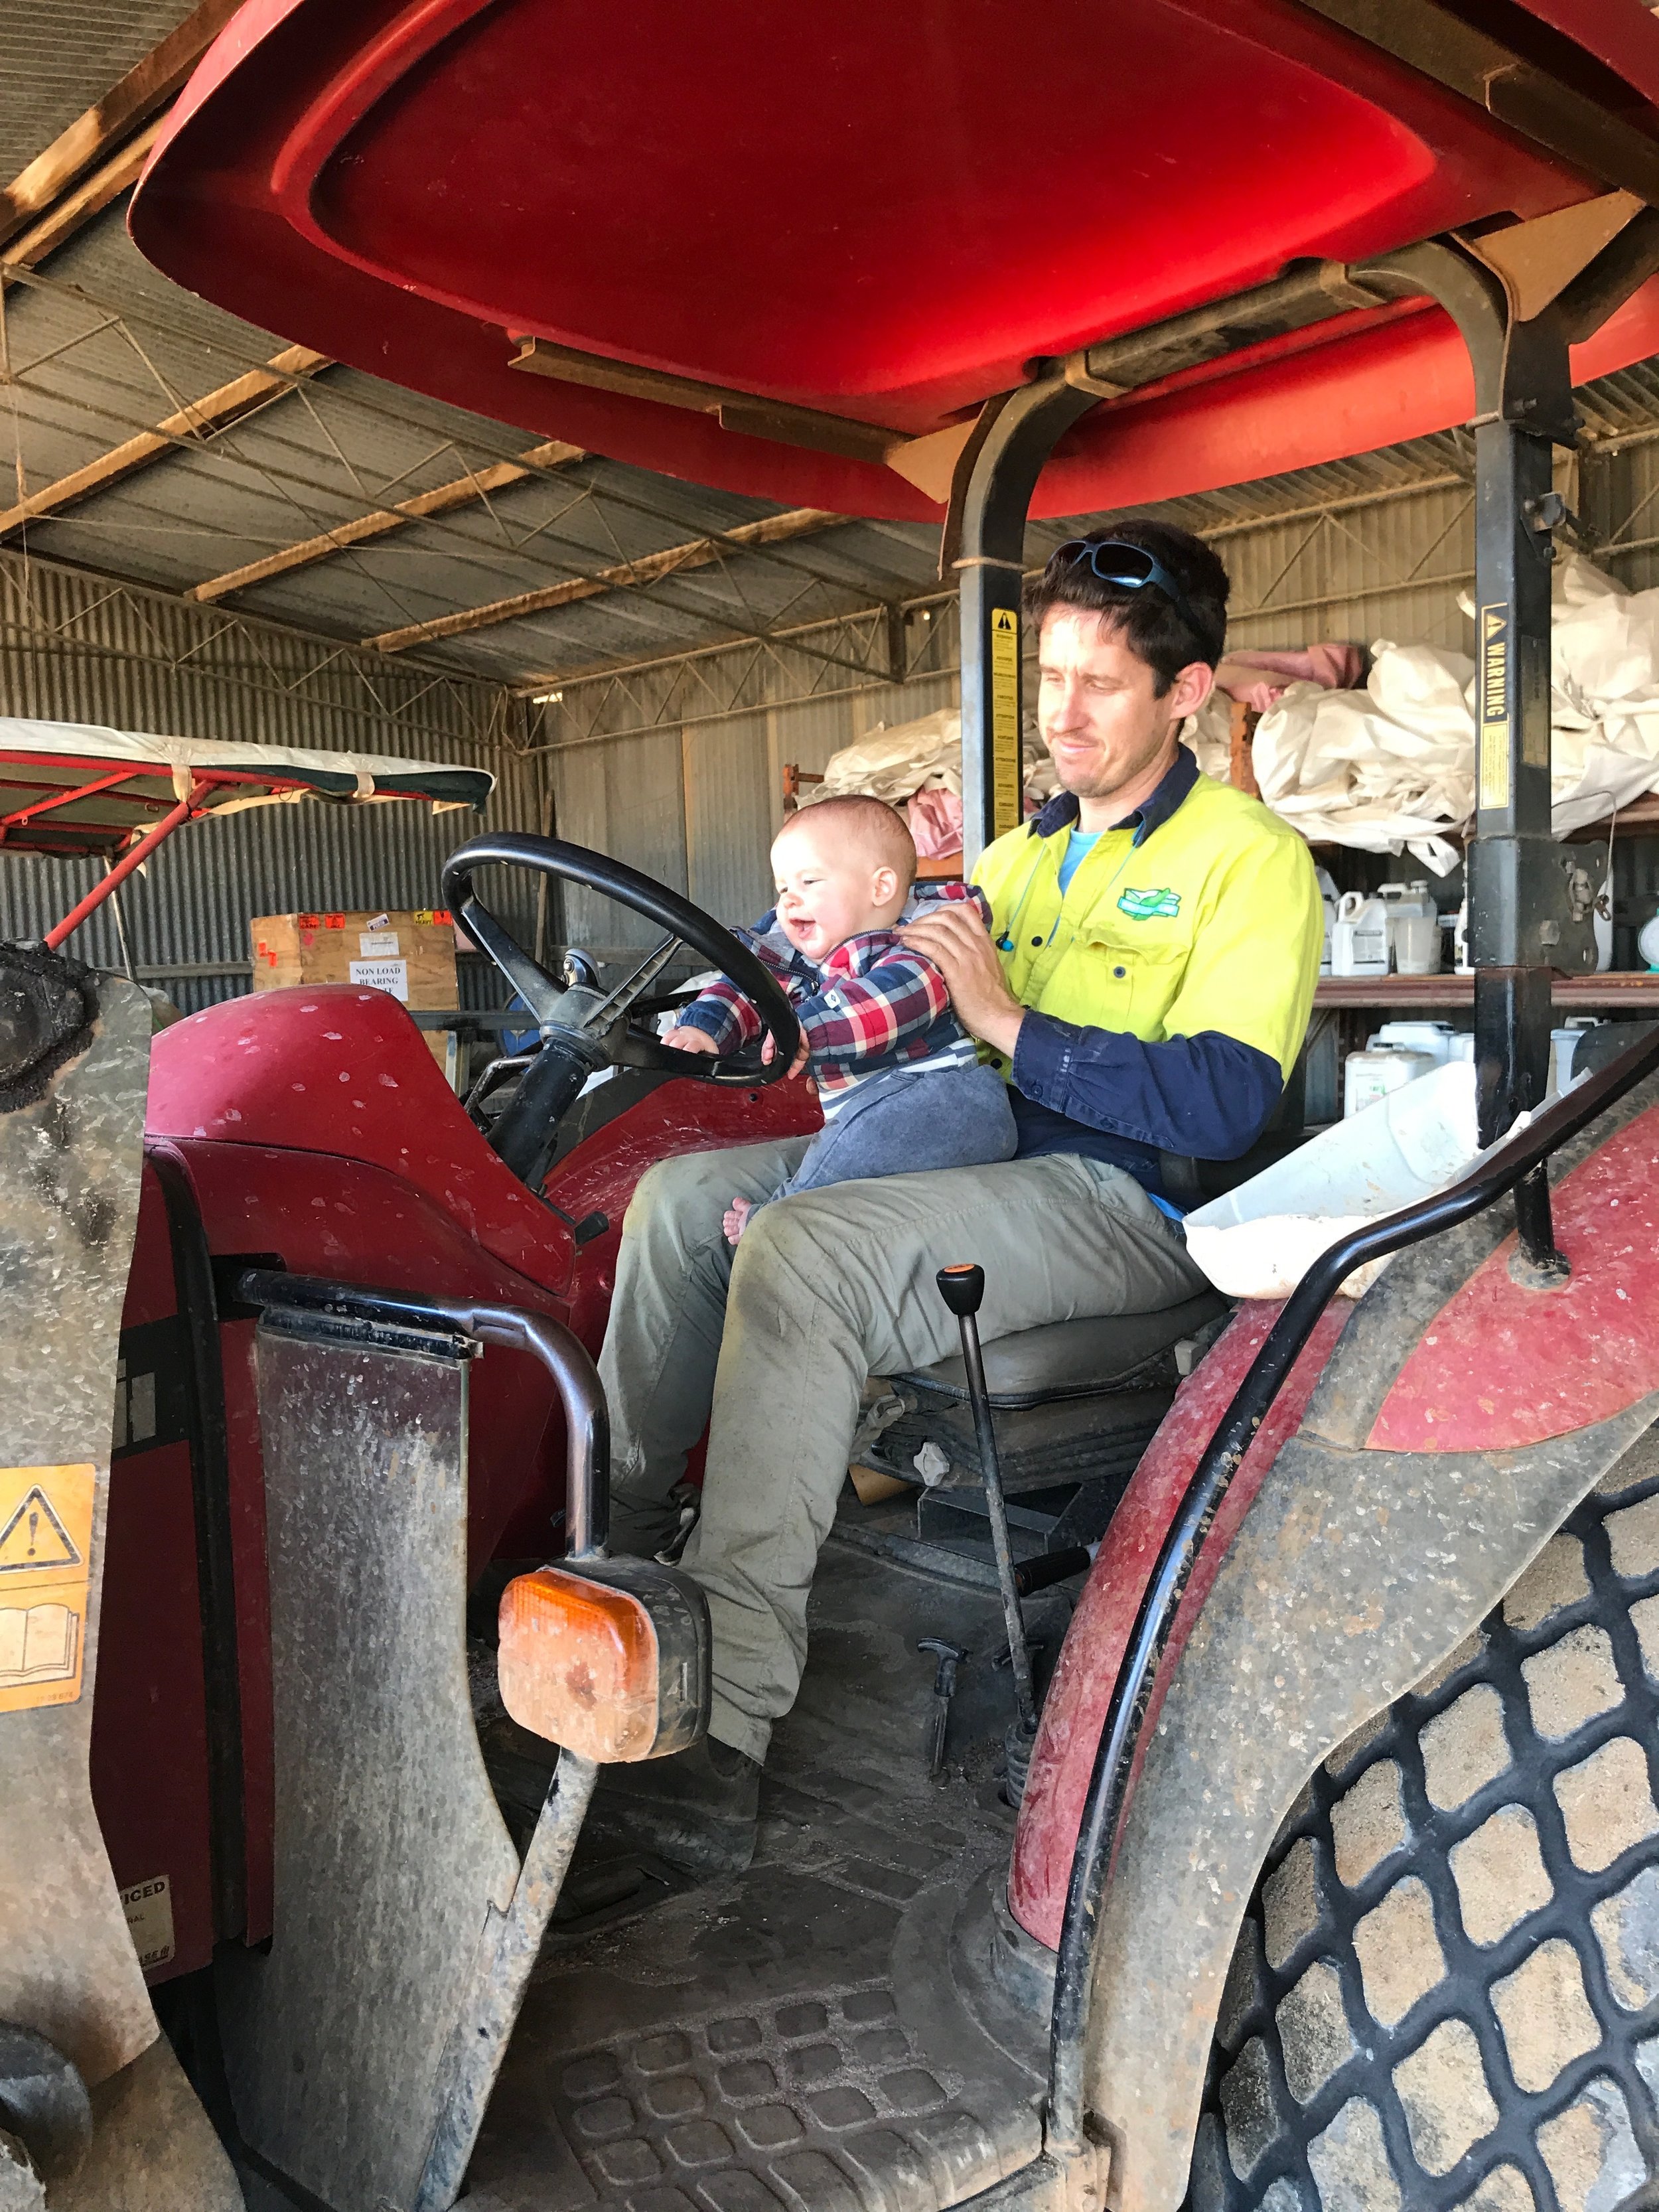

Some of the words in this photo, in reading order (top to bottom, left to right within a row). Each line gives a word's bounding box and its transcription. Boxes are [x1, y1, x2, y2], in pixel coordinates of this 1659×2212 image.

[1486, 642, 1506, 717] WARNING
[356, 968, 374, 976] NON
[377, 967, 401, 976] LOAD
[121, 1881, 165, 1905] ICED
